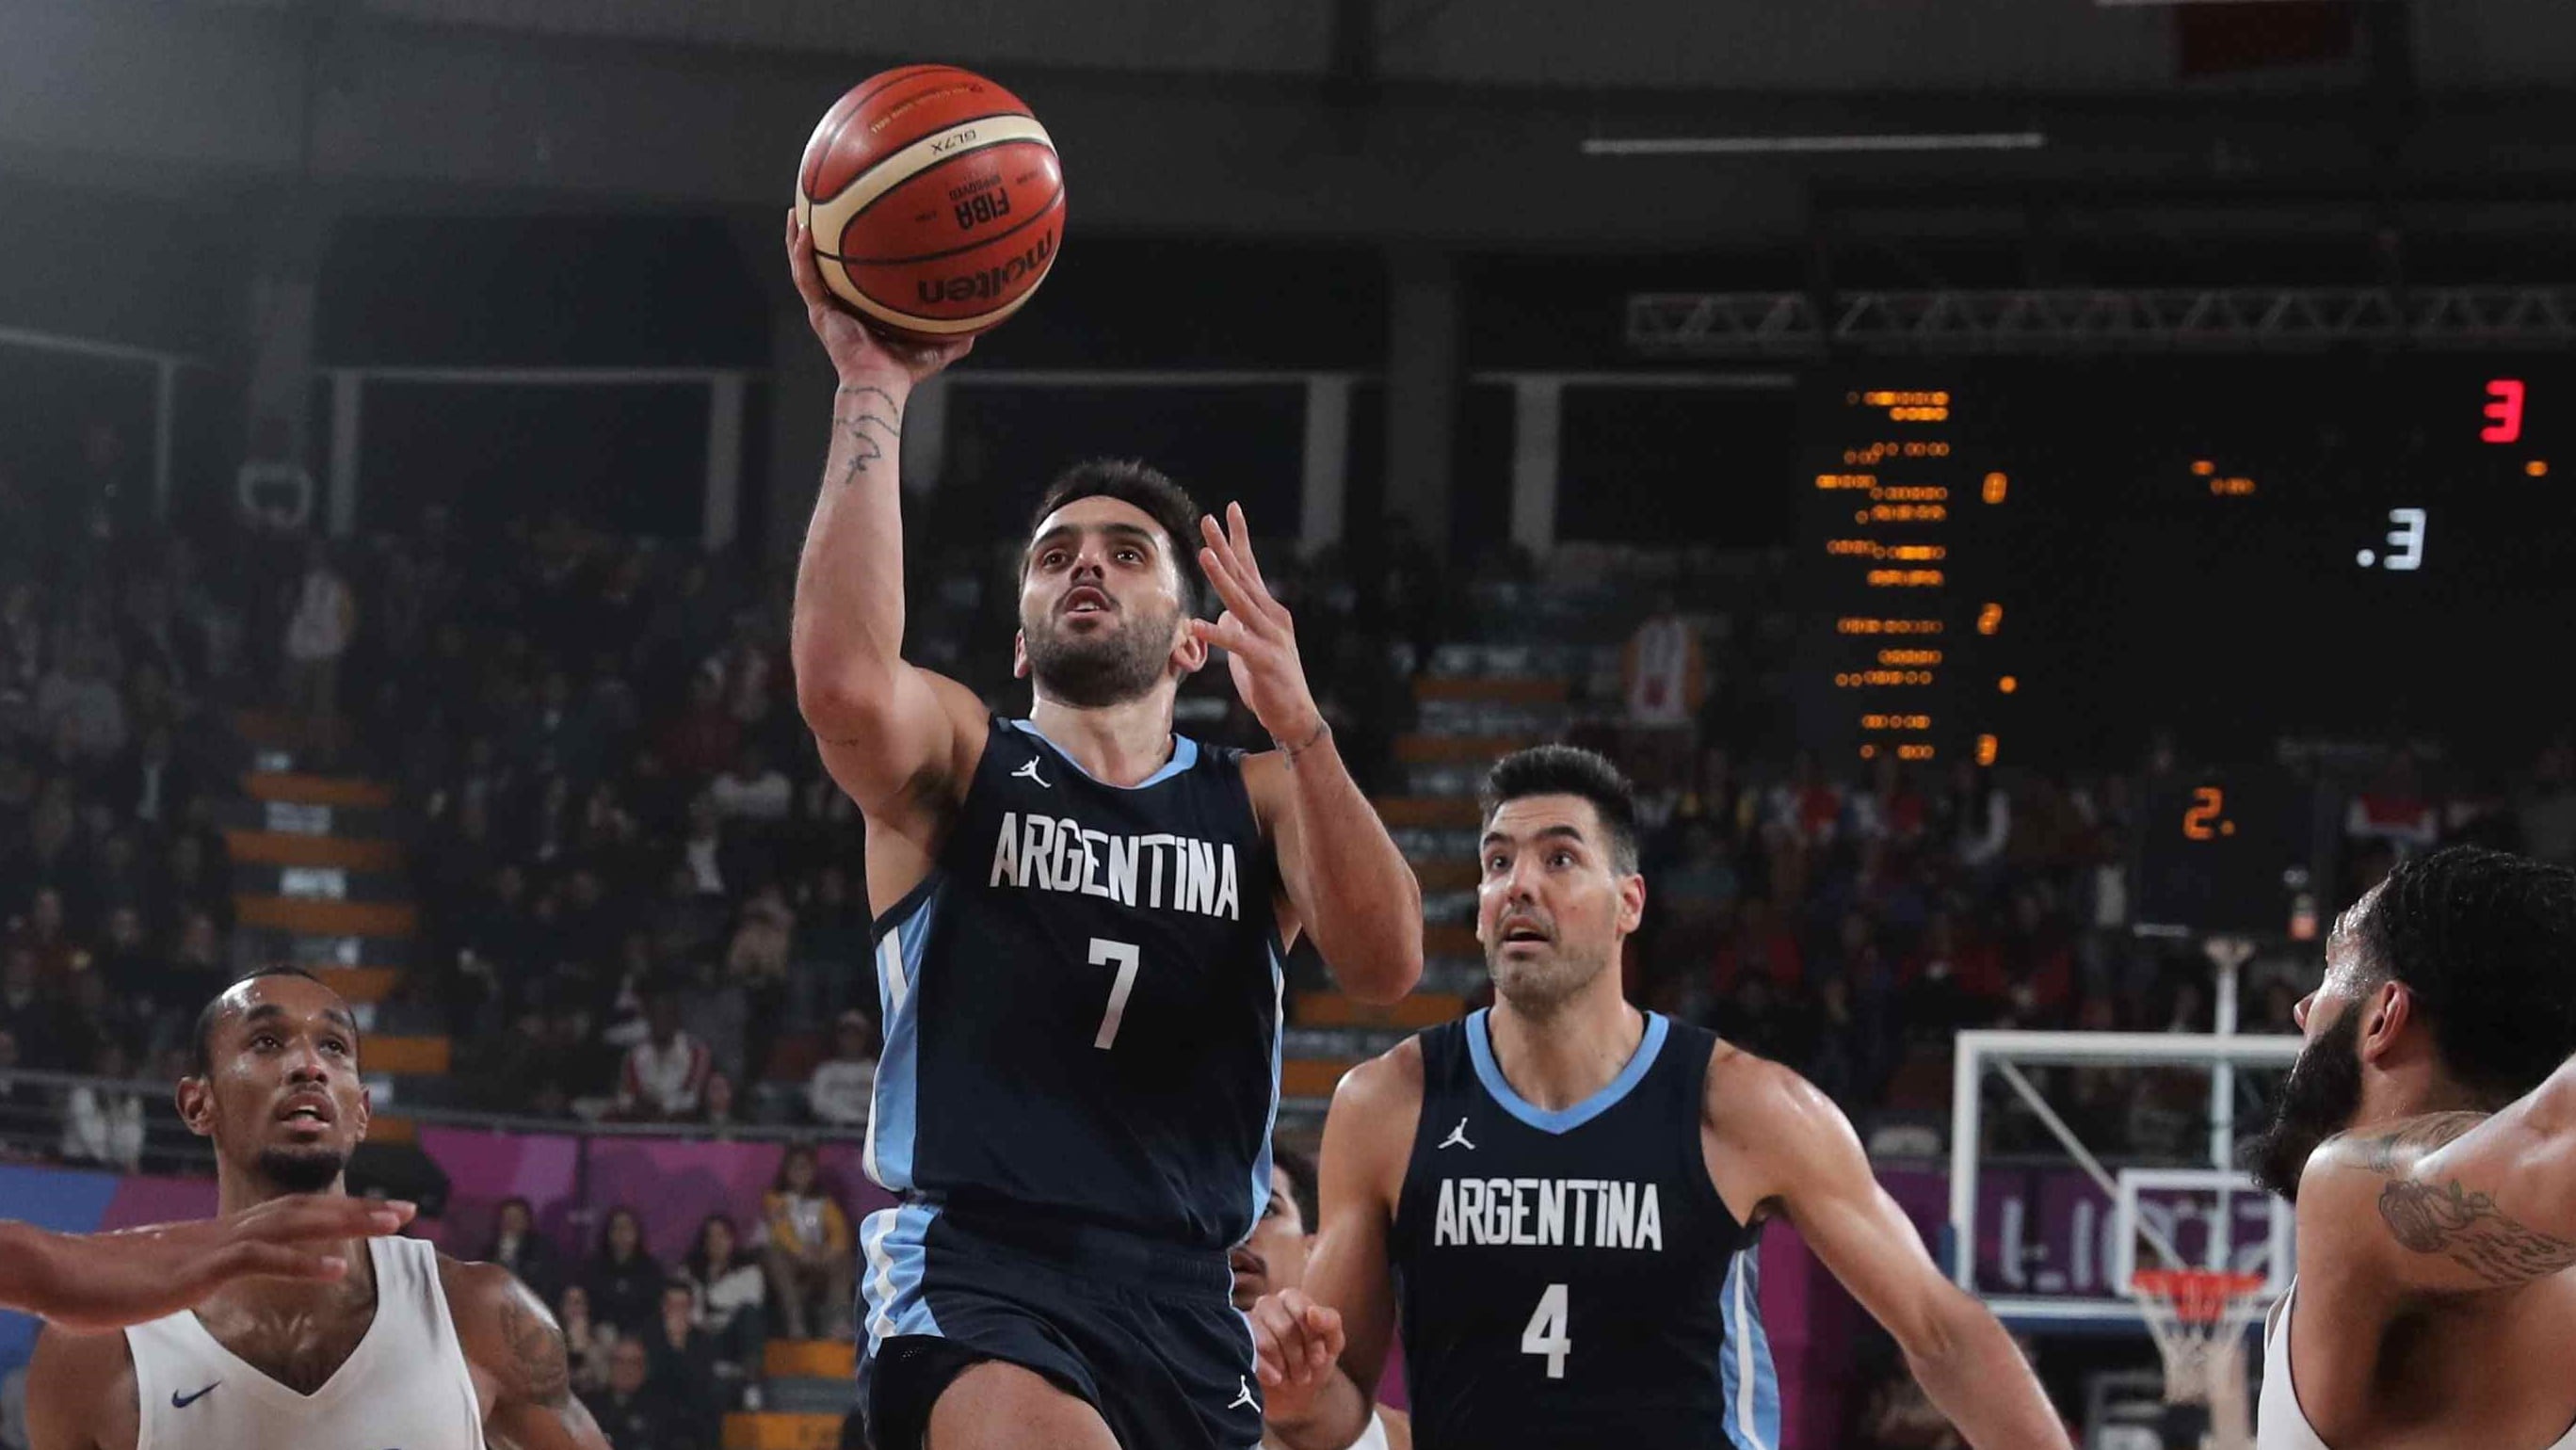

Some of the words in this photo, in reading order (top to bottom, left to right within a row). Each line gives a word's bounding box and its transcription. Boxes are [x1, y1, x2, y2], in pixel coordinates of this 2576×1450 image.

[930, 128, 977, 156] GL7X
[954, 186, 1011, 231] FIBA
[917, 226, 1053, 304] molten
[2479, 379, 2525, 443] 3
[989, 811, 1240, 922] ARGENTINA
[1087, 936, 1140, 1050] 7
[1434, 1177, 1664, 1252] ARGENTINA
[1521, 1282, 1572, 1379] 4
